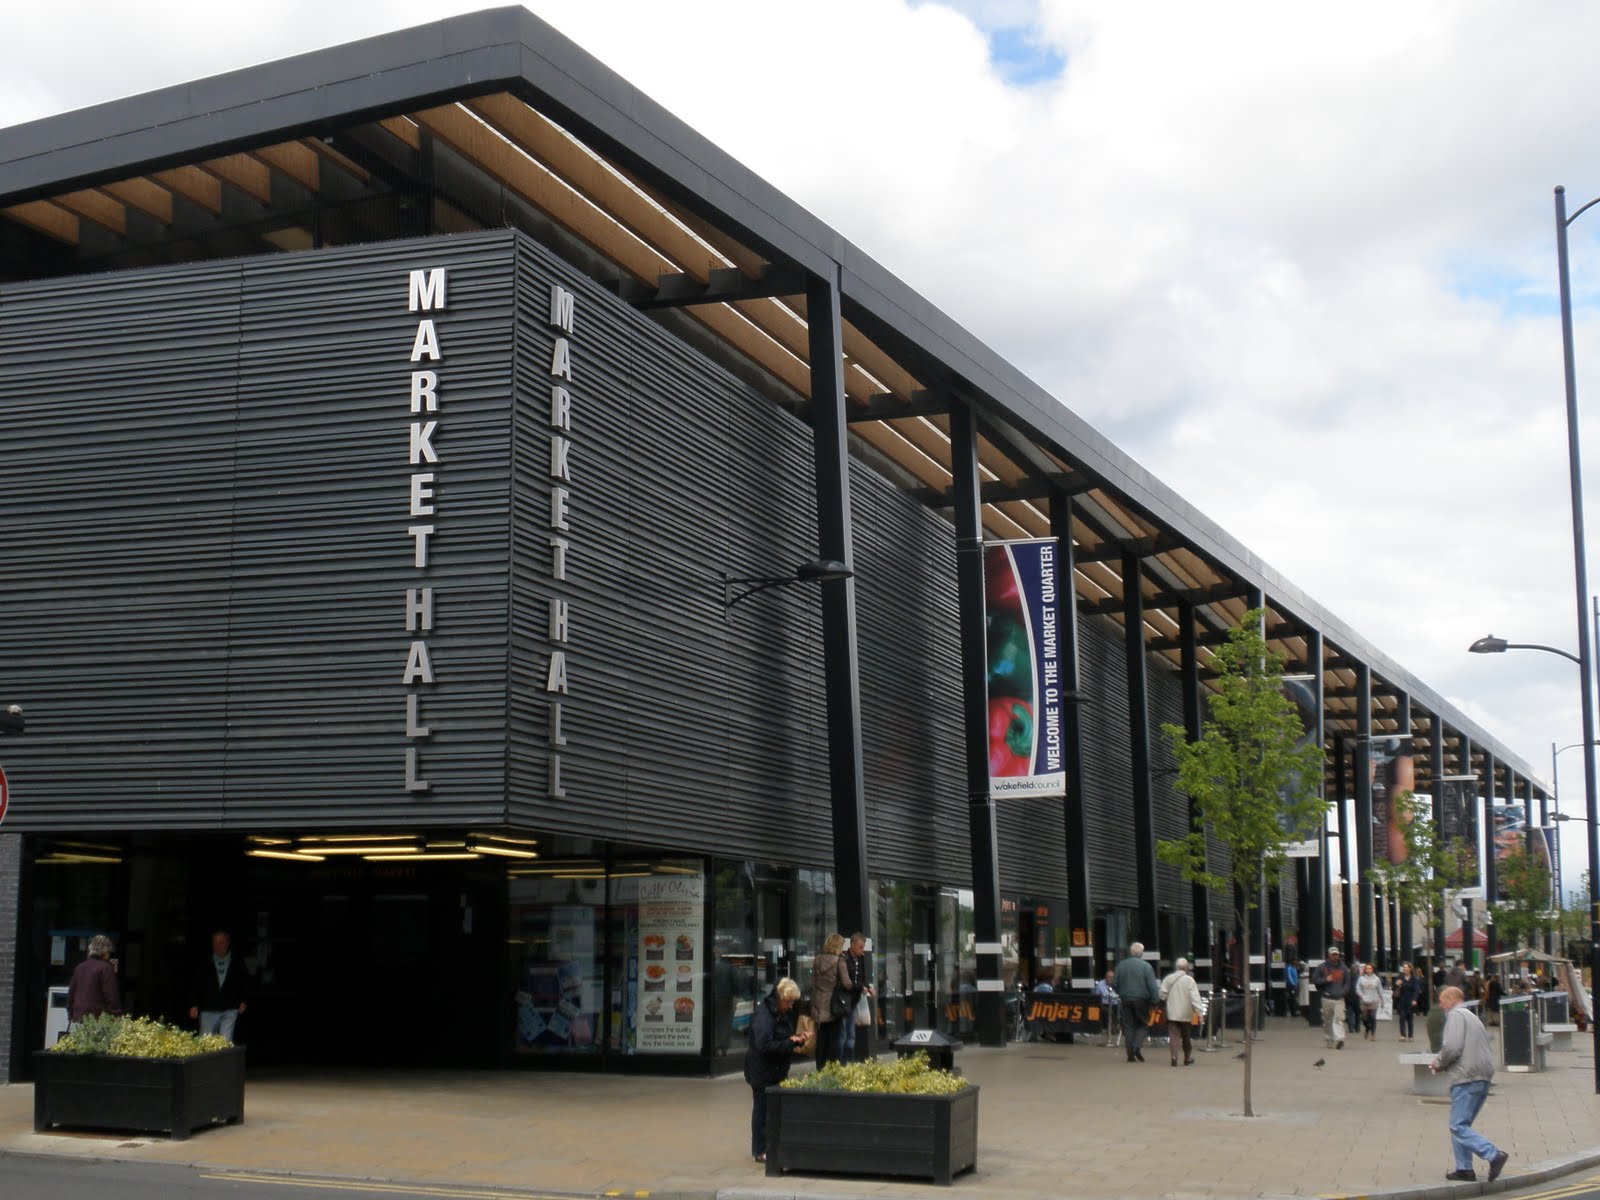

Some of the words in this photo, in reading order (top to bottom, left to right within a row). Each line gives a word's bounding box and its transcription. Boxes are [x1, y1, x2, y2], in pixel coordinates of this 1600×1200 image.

[408, 268, 445, 567] MARKET
[550, 285, 575, 580] MARKET
[1040, 545, 1056, 603] QUARTER
[1042, 605, 1057, 659] MARKET
[402, 588, 434, 791] HALL
[547, 600, 569, 798] HALL
[1044, 660, 1058, 686] THE
[1045, 686, 1058, 705] TO
[1045, 706, 1060, 770] WELCOME
